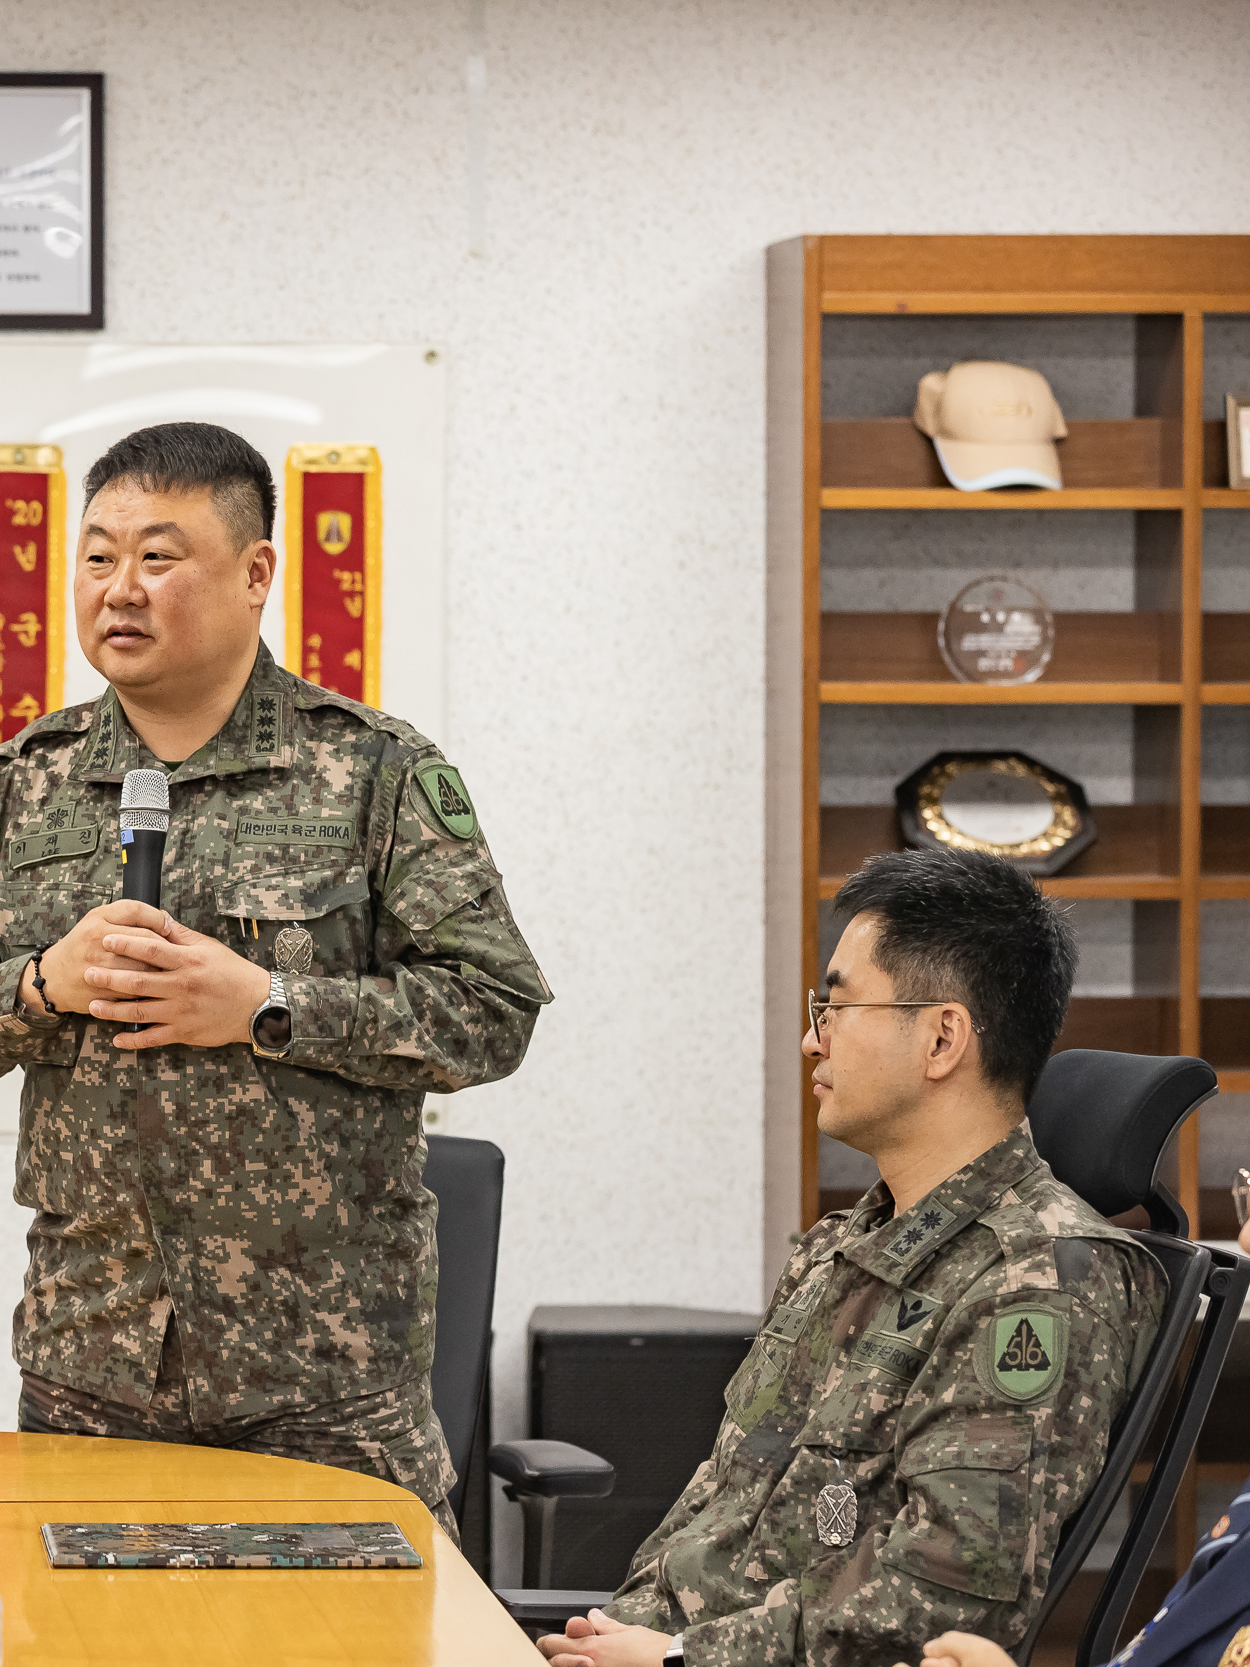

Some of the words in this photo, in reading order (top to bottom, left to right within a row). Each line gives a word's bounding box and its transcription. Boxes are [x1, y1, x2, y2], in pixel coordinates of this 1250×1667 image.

[240, 822, 289, 836] 대한민국
[291, 824, 317, 838] 육군
[318, 825, 350, 840] ROKA
[888, 1349, 922, 1375] ROKA
